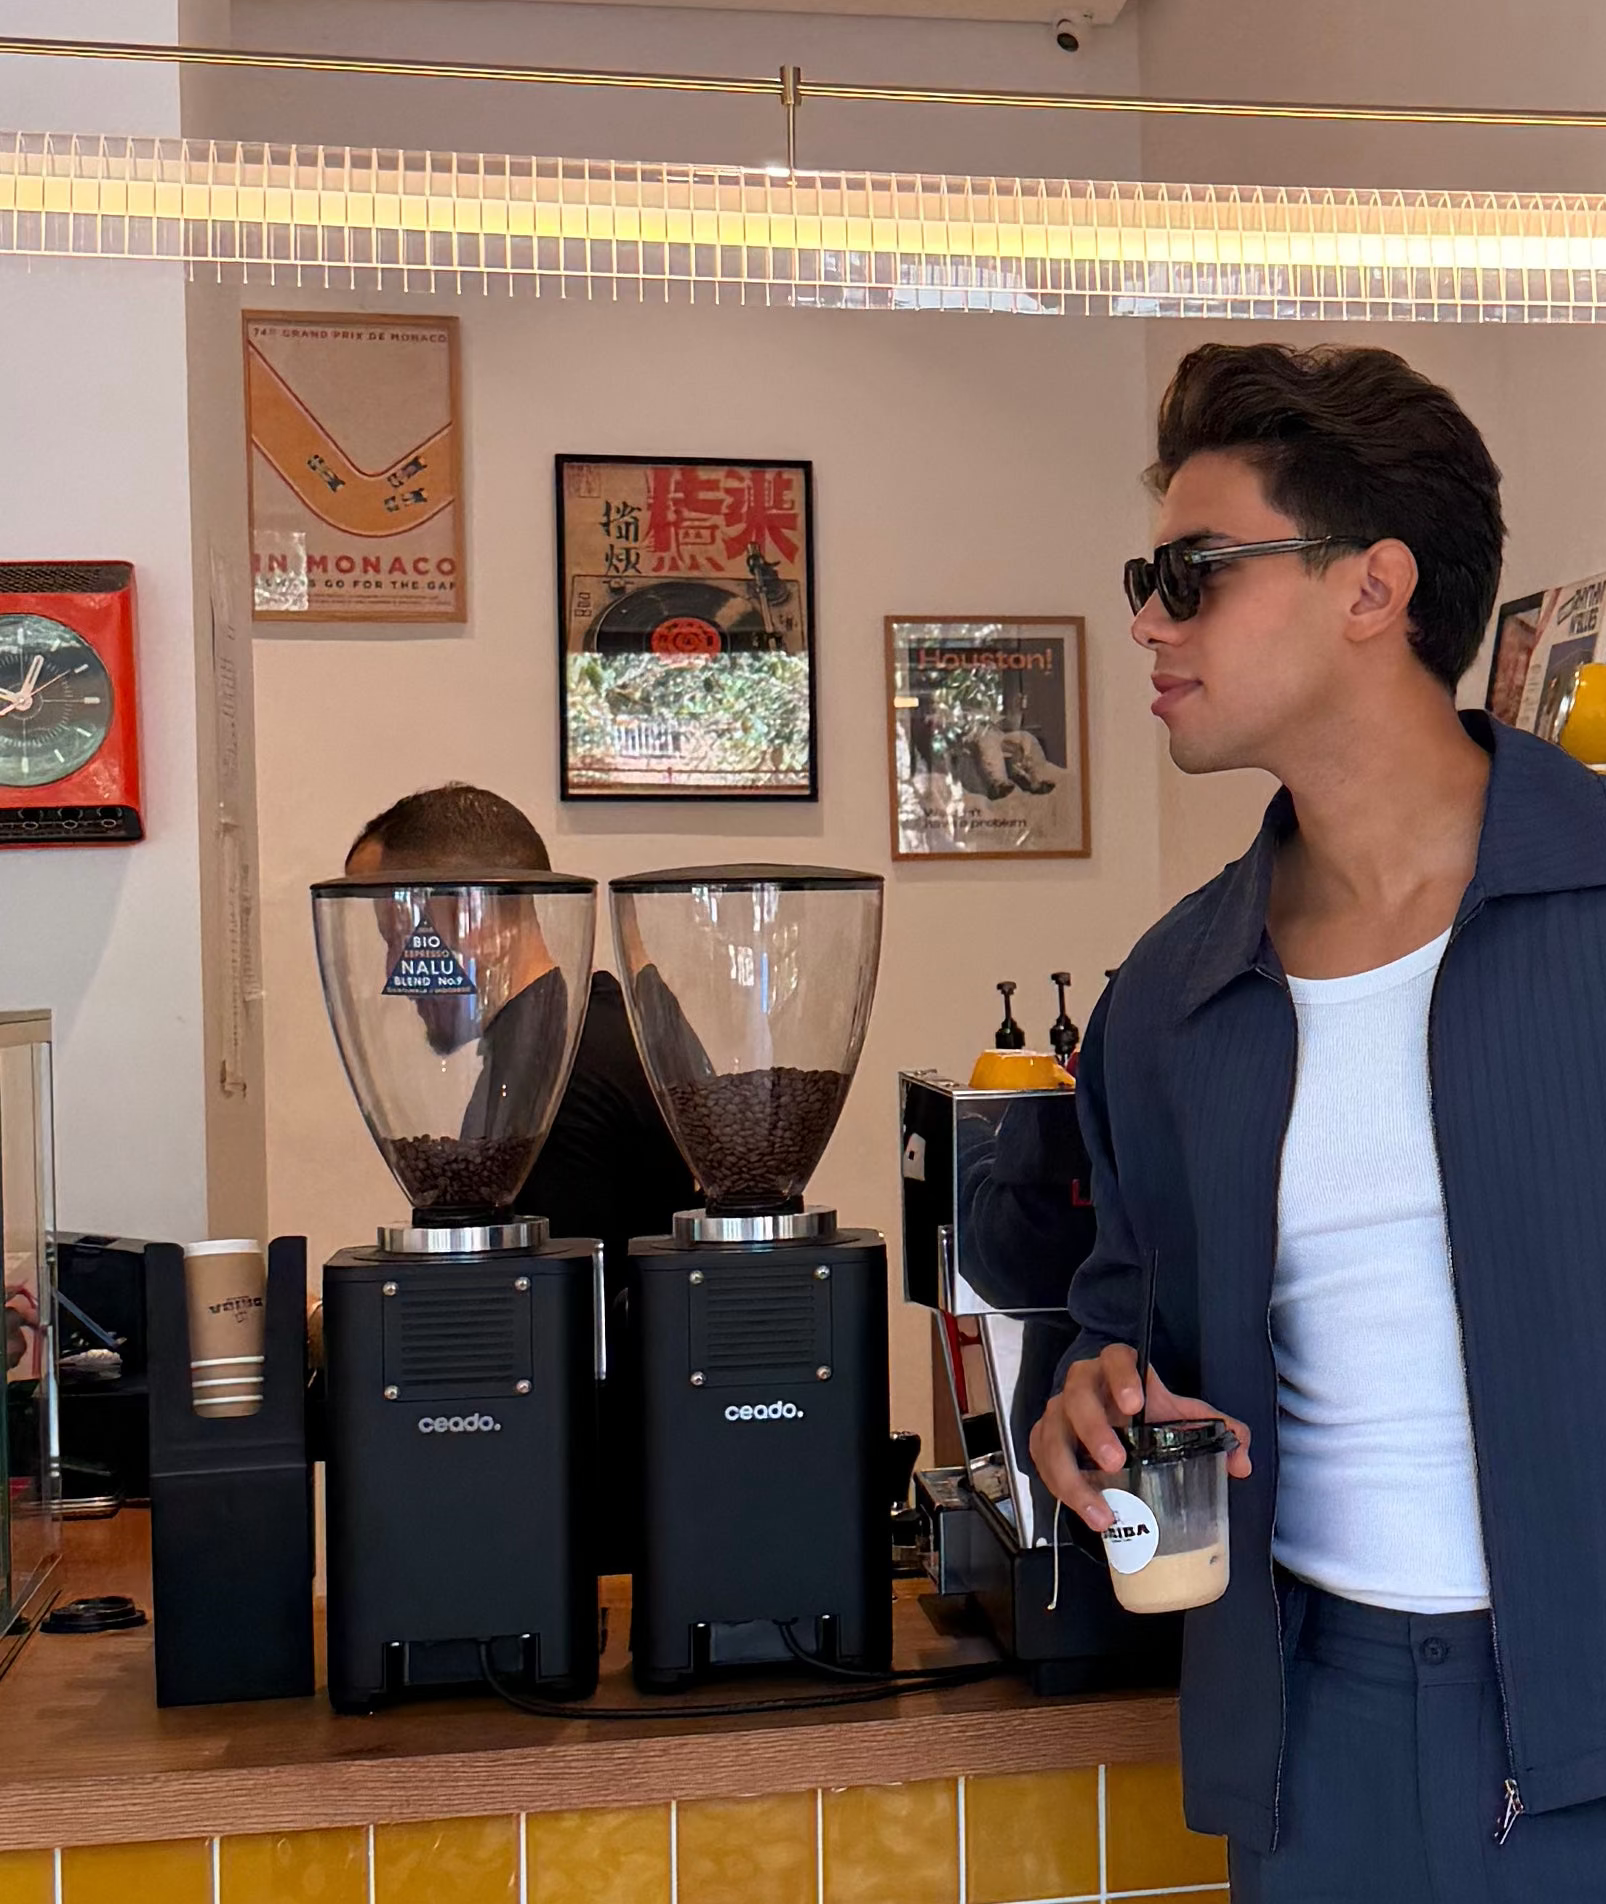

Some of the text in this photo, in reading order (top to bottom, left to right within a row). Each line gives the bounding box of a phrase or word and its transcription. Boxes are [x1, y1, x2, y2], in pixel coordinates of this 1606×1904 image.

[282, 328, 328, 339] GRAND
[333, 330, 363, 340] PRIX
[367, 331, 384, 341] DE
[390, 332, 448, 343] MONACO
[306, 554, 457, 576] MONACO
[324, 579, 345, 588] GO
[352, 579, 383, 589] FOR
[390, 580, 420, 590] THE
[917, 648, 1052, 675] Houston!
[971, 818, 1027, 829] problem
[413, 935, 441, 948] BIO
[401, 959, 454, 975] NALU
[394, 976, 431, 987] BLEND
[724, 1400, 804, 1422] ceado.
[419, 1413, 501, 1433] ceado.
